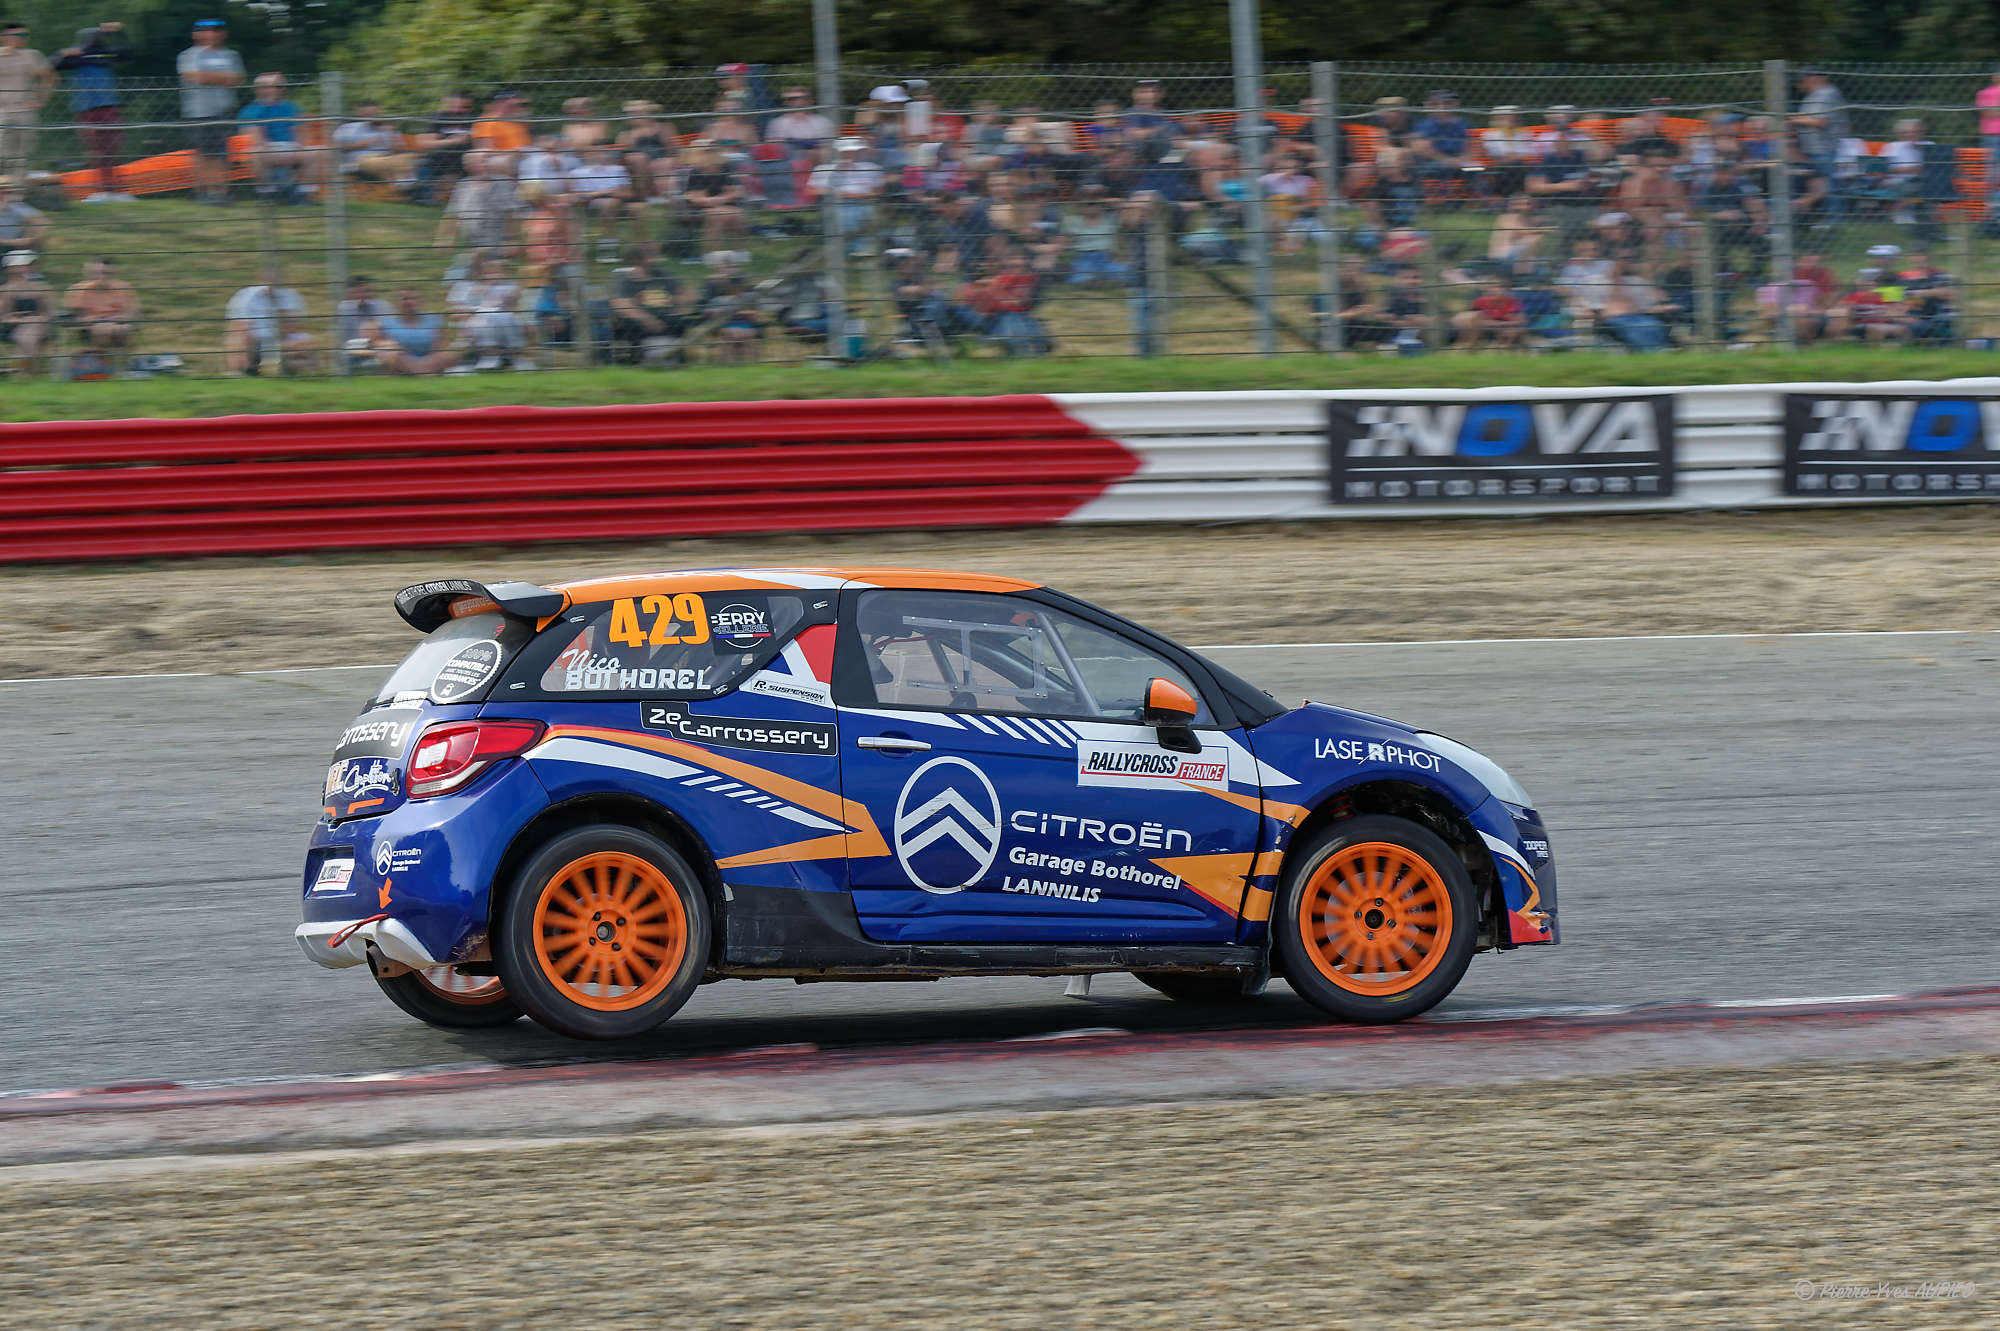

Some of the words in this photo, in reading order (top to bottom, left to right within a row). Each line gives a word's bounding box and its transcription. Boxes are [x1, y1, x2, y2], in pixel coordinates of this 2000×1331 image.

[1346, 401, 1660, 457] NOVA
[1799, 400, 2000, 452] NO
[1344, 475, 1660, 498] MOTORSPORT
[609, 593, 710, 648] 429
[711, 612, 765, 626] BERRY
[447, 659, 491, 674] COMPATIBLE
[562, 649, 621, 671] Nico
[565, 668, 712, 691] BOTHOREL
[768, 685, 824, 700] SUSPENSION
[649, 708, 682, 725] Ze
[679, 720, 829, 750] Carrossery
[1088, 751, 1178, 774] RALLYCROSS
[1179, 763, 1225, 780] FRANCE
[1009, 846, 1086, 876] Garage
[1090, 859, 1182, 890] Bothorel
[1002, 876, 1102, 903] LANNILIS
